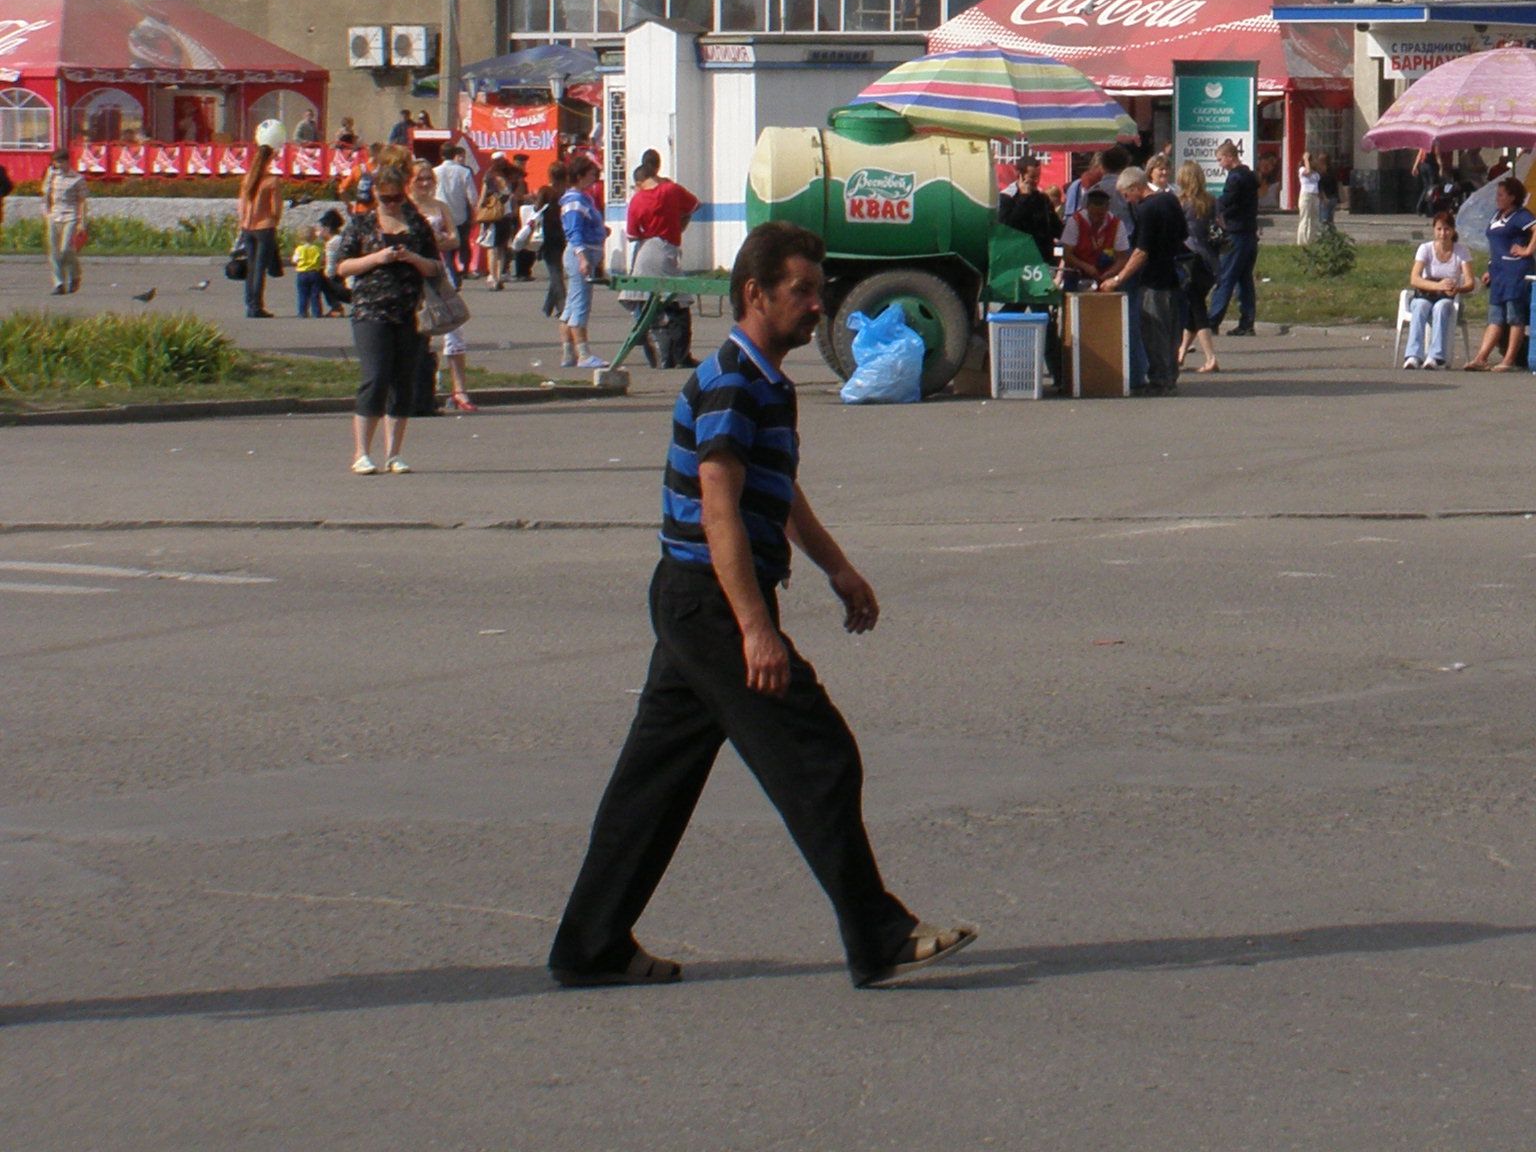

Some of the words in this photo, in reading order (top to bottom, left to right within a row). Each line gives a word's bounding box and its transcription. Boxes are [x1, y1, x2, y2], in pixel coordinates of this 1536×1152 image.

[1391, 42, 1398, 53] С
[1401, 42, 1471, 54] ПРАЗДНИКОМ
[1391, 53, 1463, 71] БАРНАУ
[471, 129, 558, 151] ШАШЛЫК
[1187, 137, 1219, 147] ОБМЕН
[850, 198, 910, 220] КВАС
[1022, 264, 1043, 282] 56
